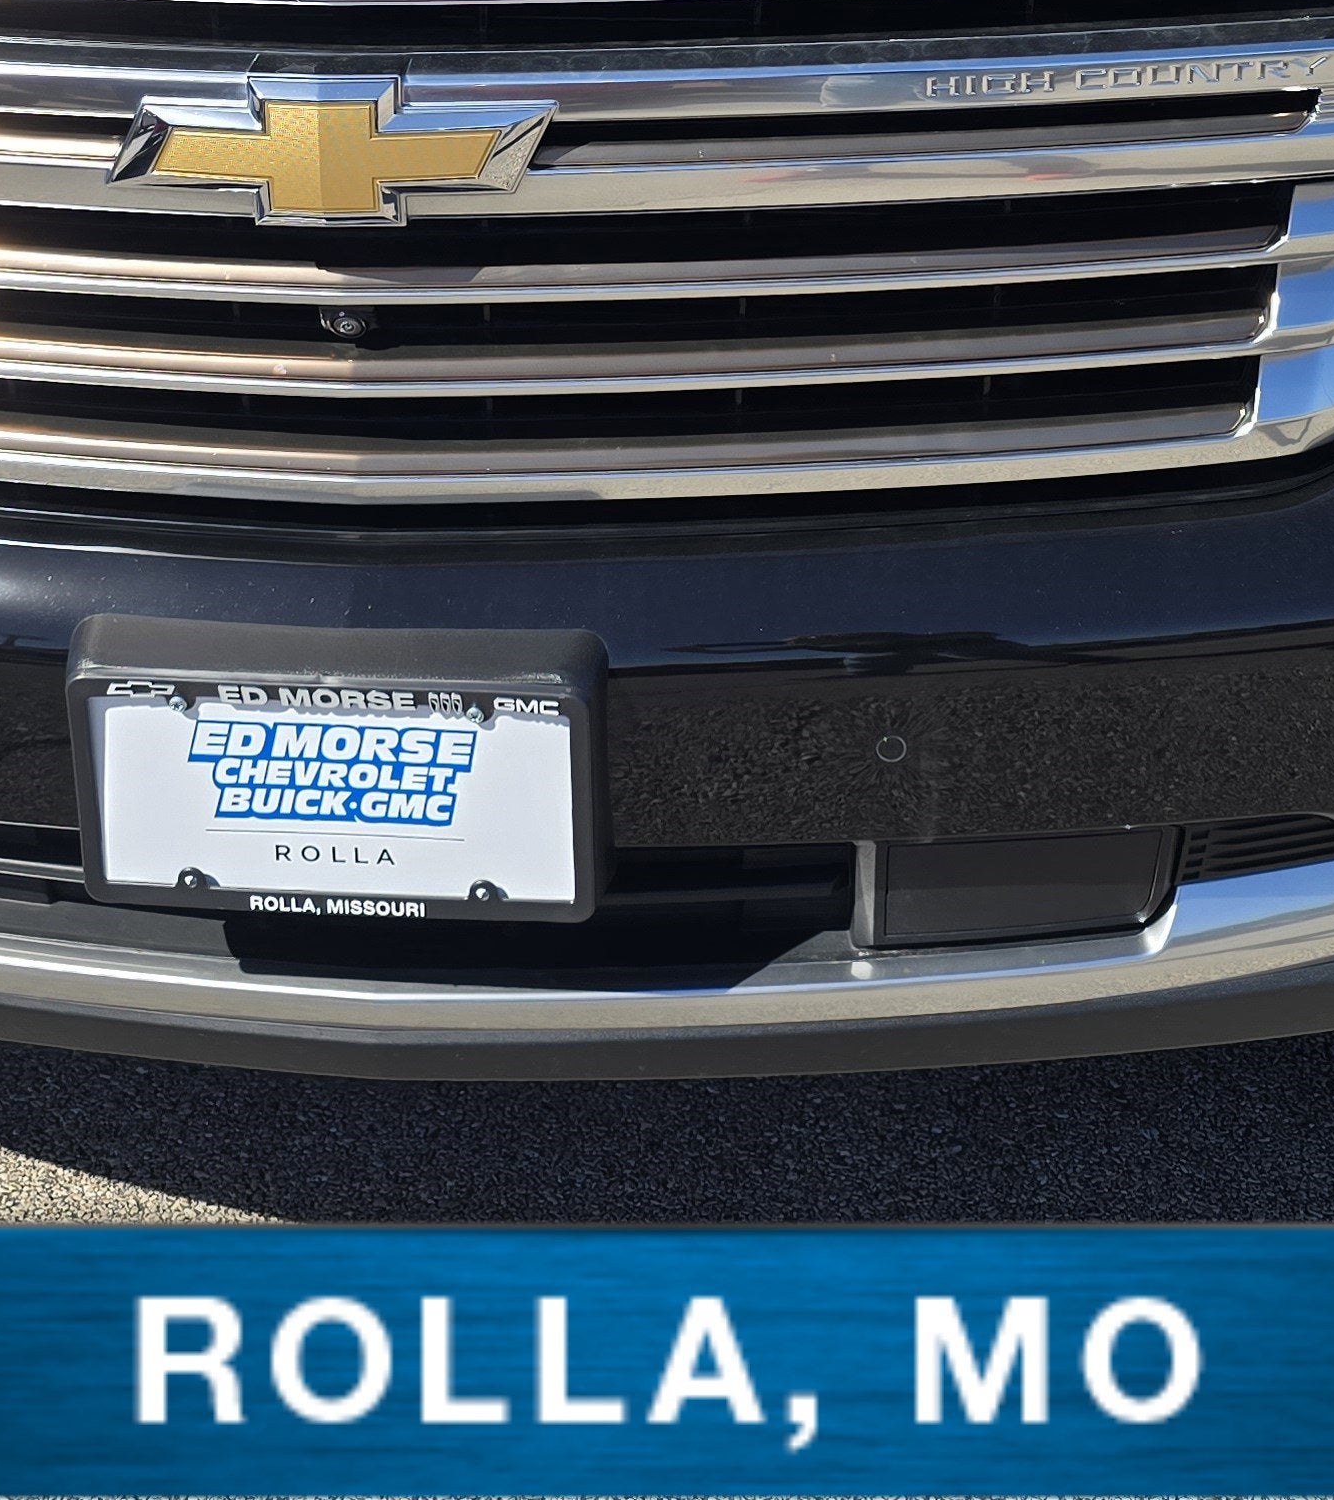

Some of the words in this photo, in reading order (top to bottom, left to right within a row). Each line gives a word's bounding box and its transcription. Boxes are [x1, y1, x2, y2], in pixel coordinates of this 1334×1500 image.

[926, 70, 1055, 97] HIGH
[1075, 54, 1328, 90] COUNTRY
[217, 684, 267, 706] ED
[278, 687, 417, 711] MORSE
[494, 696, 560, 716] GMC
[191, 721, 267, 756] ED
[270, 724, 475, 766] MORSE
[216, 757, 453, 793] CHEVROLET
[275, 844, 395, 865] ROLLA
[249, 895, 321, 916] ROLLA,
[326, 899, 426, 918] MISSOURI
